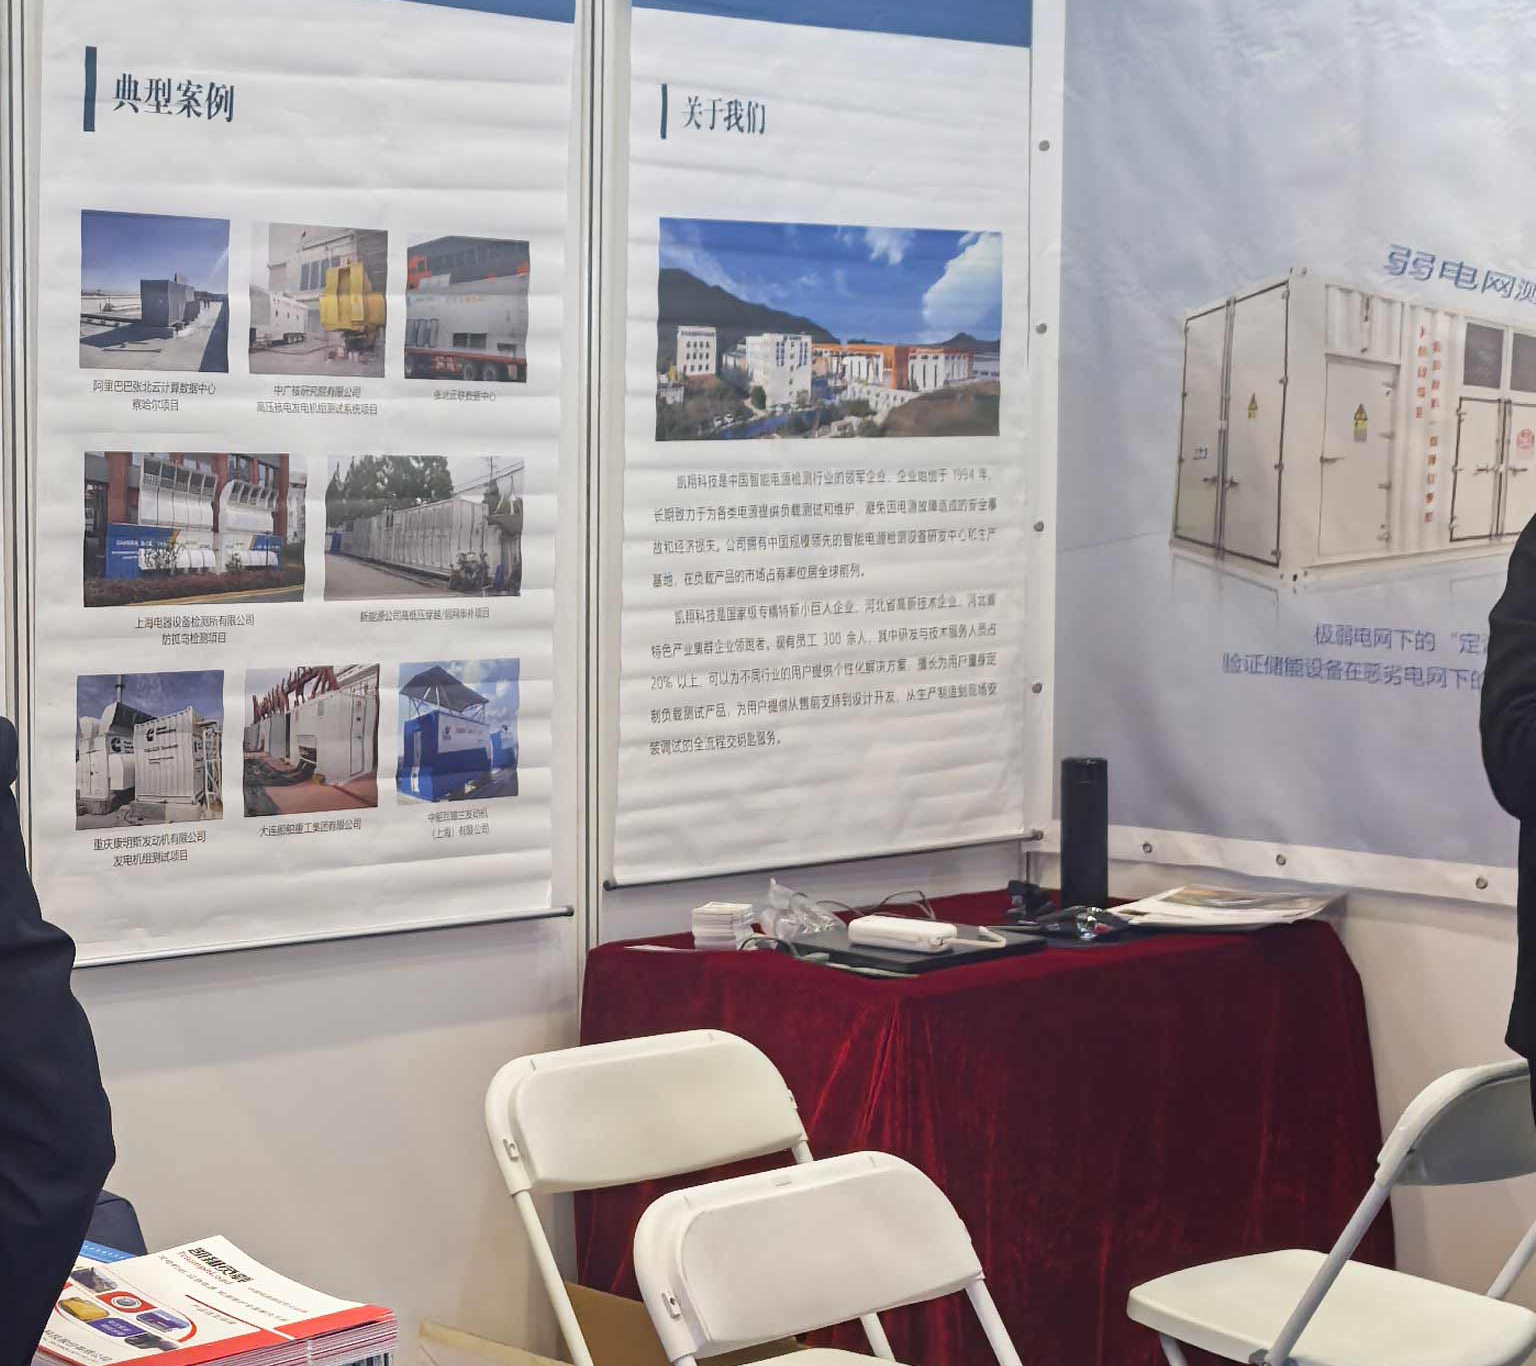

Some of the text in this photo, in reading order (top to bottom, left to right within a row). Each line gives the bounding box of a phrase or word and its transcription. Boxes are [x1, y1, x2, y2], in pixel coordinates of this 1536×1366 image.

[112, 73, 235, 123] 典型案例
[682, 95, 766, 136] 关于我们
[1314, 622, 1488, 655] 极弱电网下的“定
